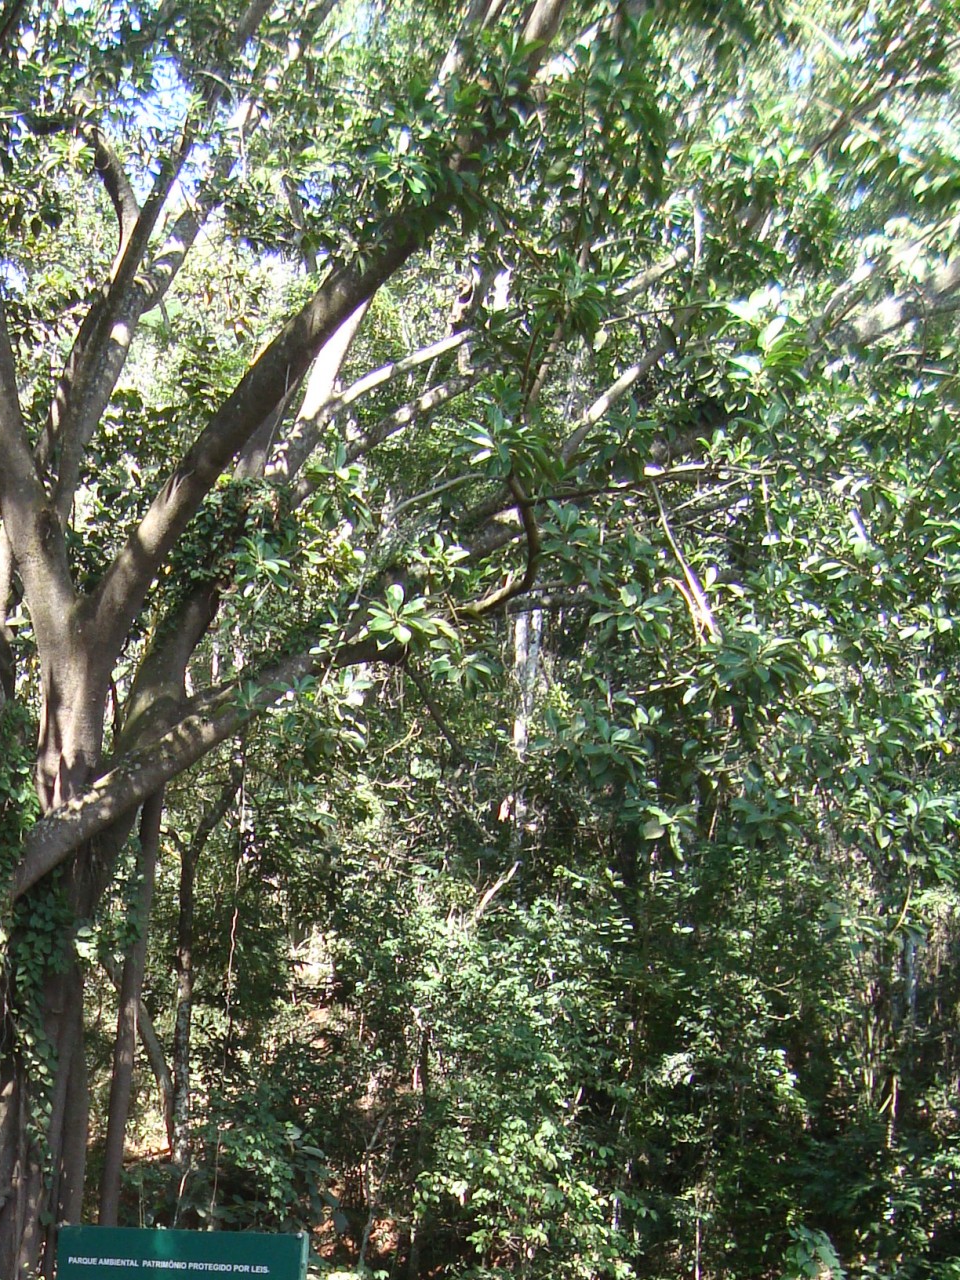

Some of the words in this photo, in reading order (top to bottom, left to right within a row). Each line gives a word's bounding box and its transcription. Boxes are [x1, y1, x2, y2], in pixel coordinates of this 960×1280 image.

[68, 1256, 97, 1265] PARQUE
[98, 1258, 139, 1267] AMBIENTAL
[142, 1260, 187, 1269] PATRIMÔNIO
[188, 1262, 232, 1271] PROTEGIDO
